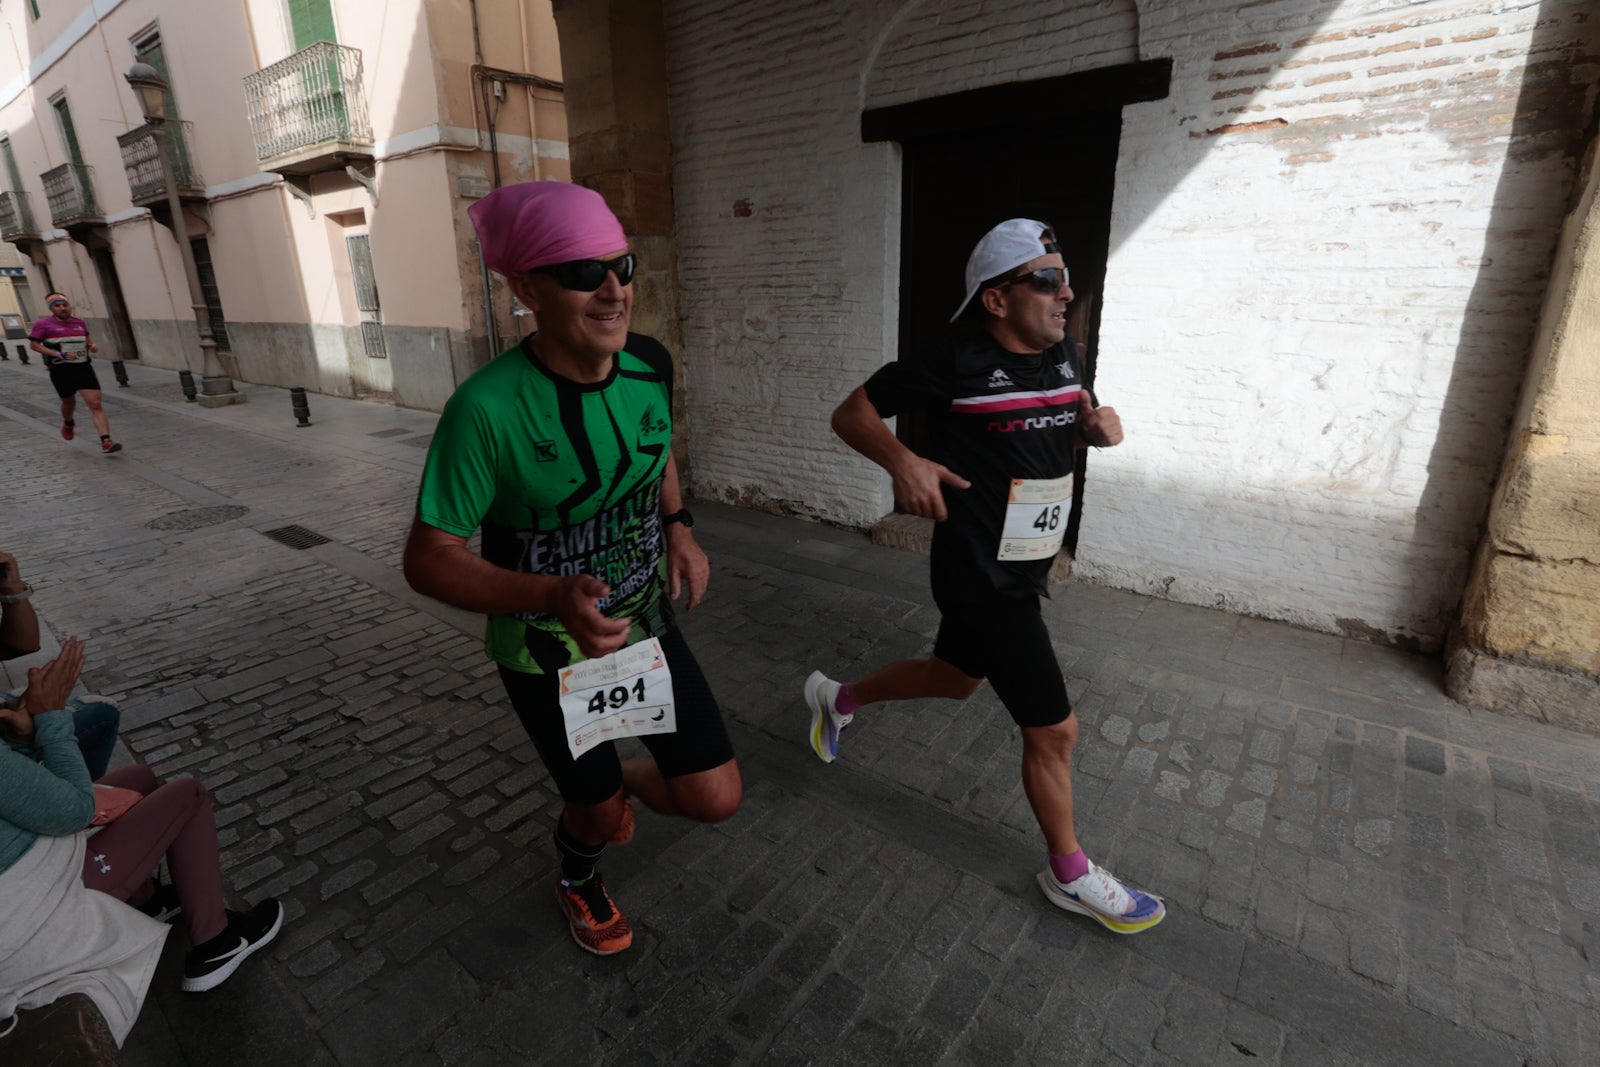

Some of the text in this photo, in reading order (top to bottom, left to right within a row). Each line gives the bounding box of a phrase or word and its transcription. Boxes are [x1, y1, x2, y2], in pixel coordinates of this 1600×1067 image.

[1033, 505, 1060, 532] 48
[514, 517, 598, 573] TEAM
[587, 677, 645, 714] 491
